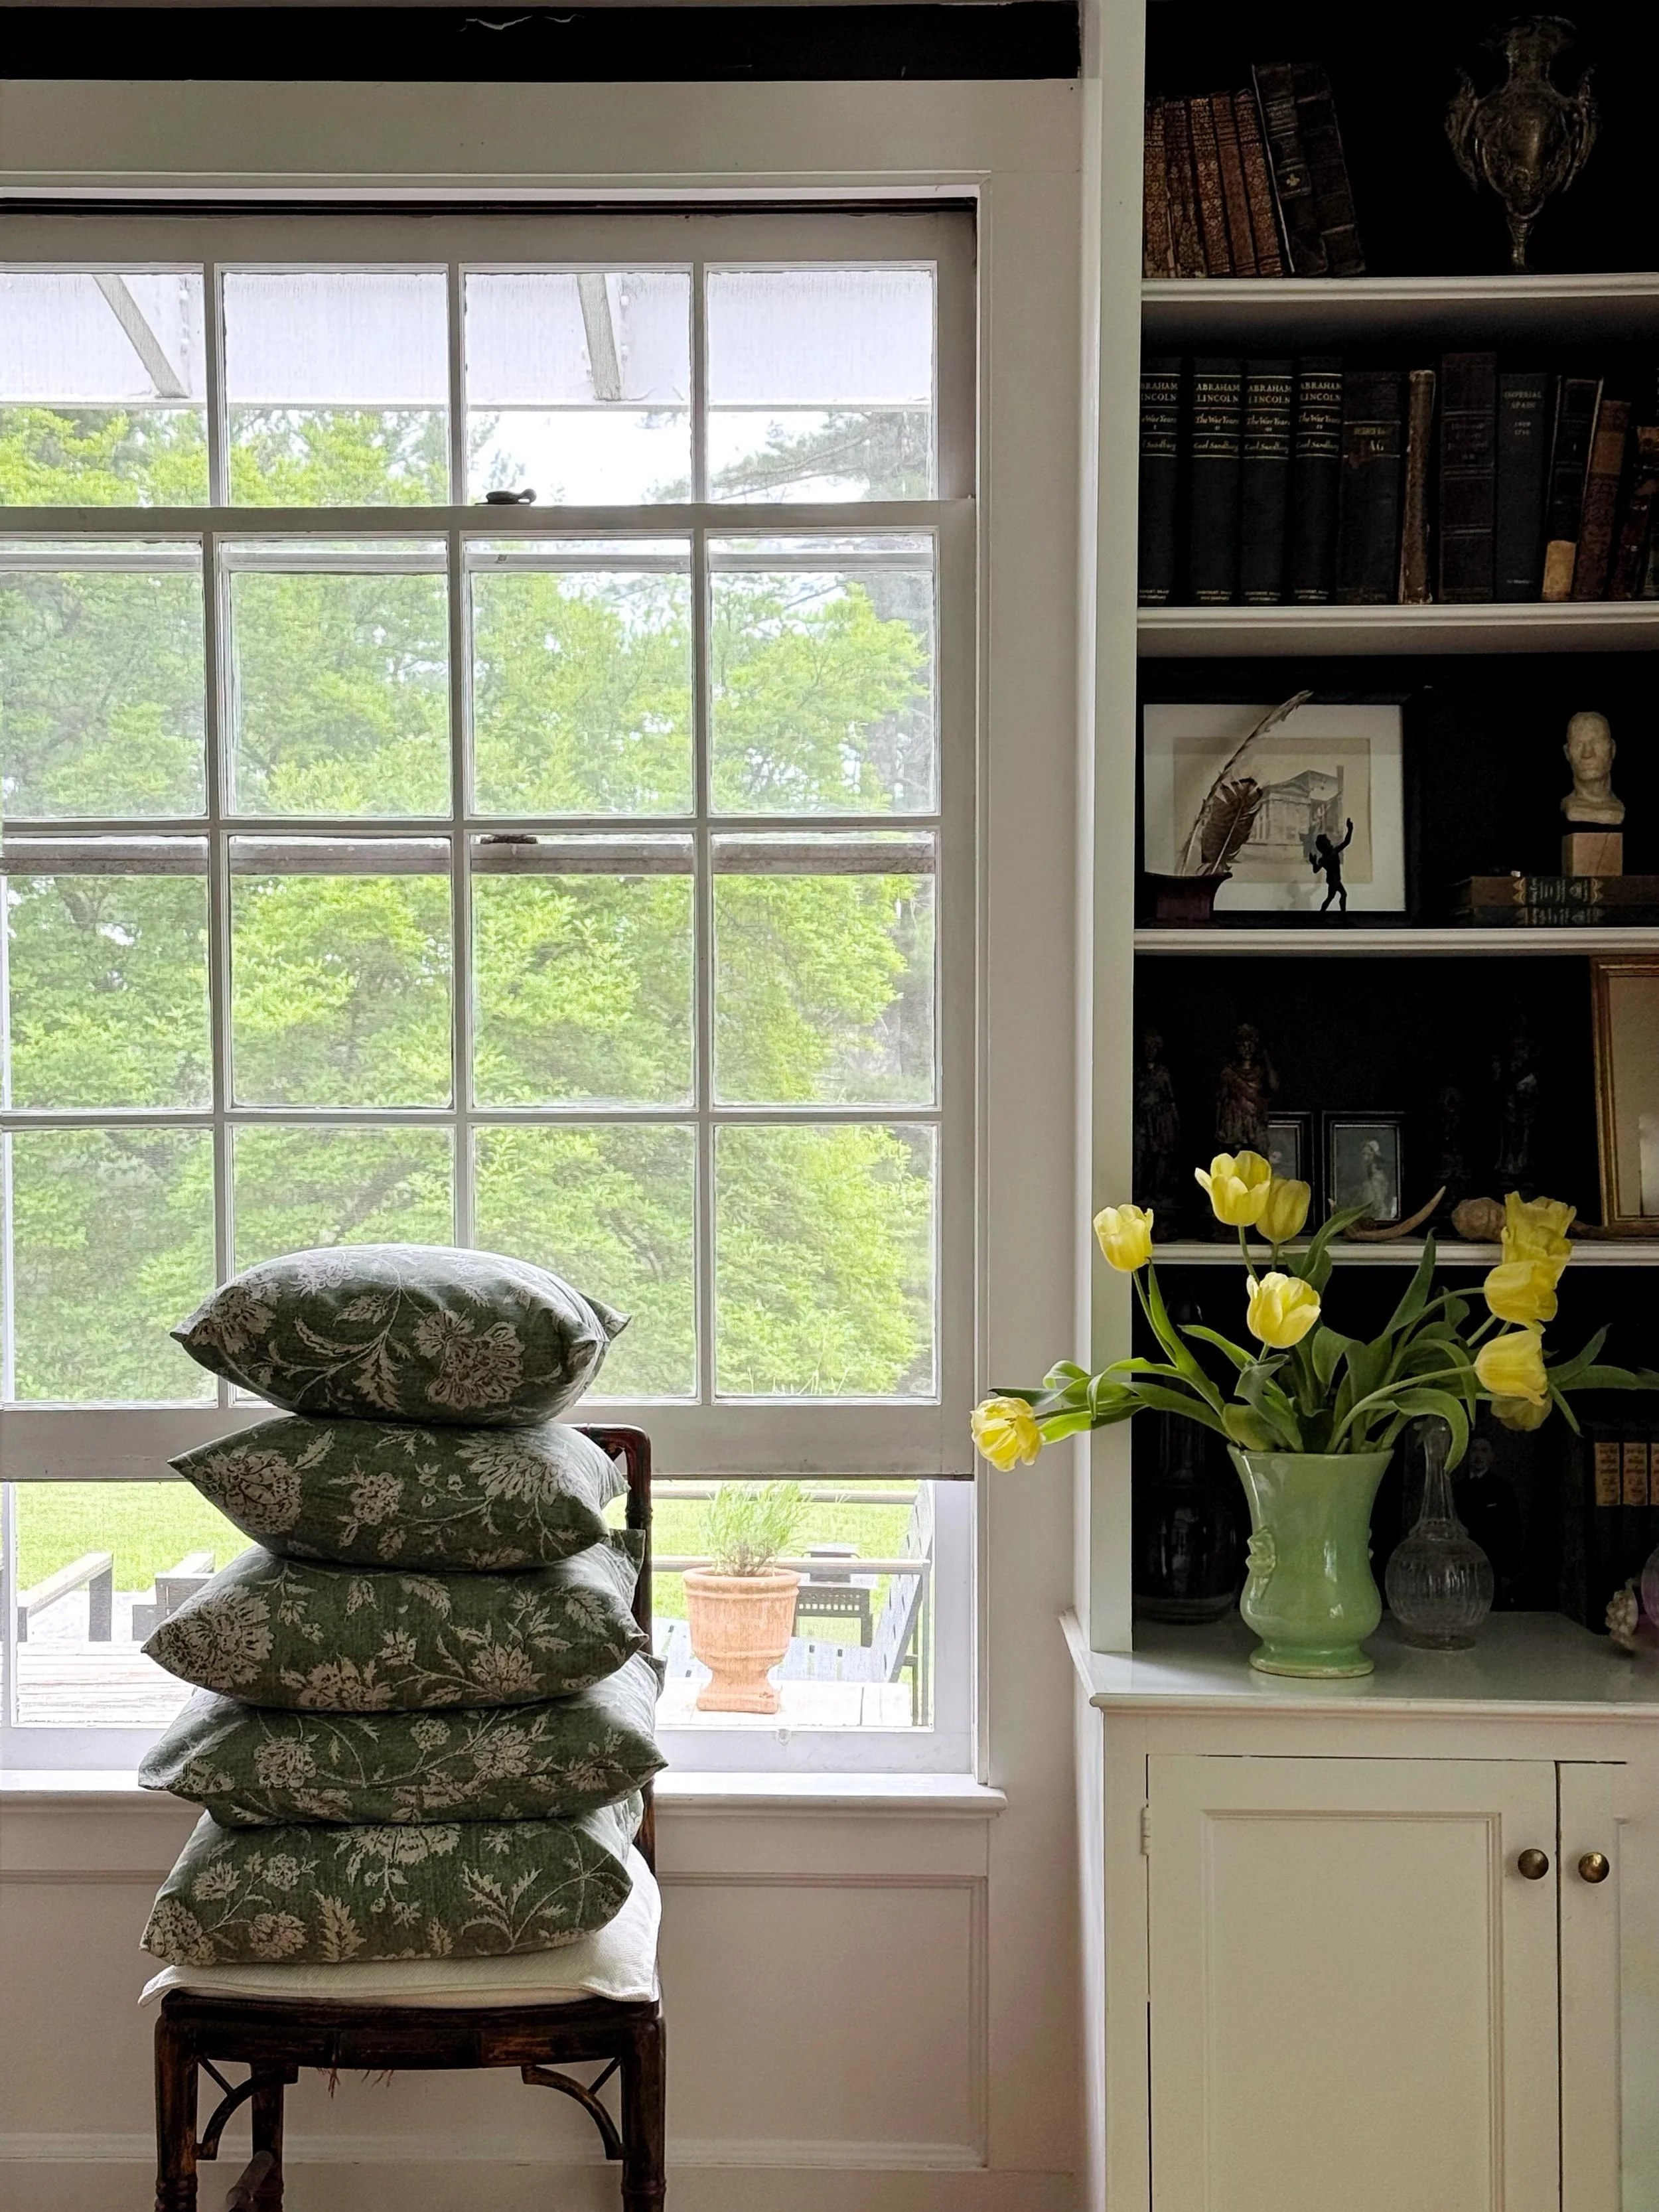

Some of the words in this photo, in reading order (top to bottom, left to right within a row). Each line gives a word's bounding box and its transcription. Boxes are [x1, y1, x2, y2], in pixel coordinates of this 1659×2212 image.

[1141, 382, 1179, 390] BRAHAM
[1195, 383, 1240, 392] ABRAHAM
[1248, 384, 1292, 392] ABRAHAM
[1300, 381, 1342, 390] ABRAHAM
[1141, 392, 1177, 402] INCOLN
[1196, 394, 1239, 403] LINCOLN
[1248, 395, 1291, 404] LINCOLN
[1299, 392, 1341, 402] LINCOLN
